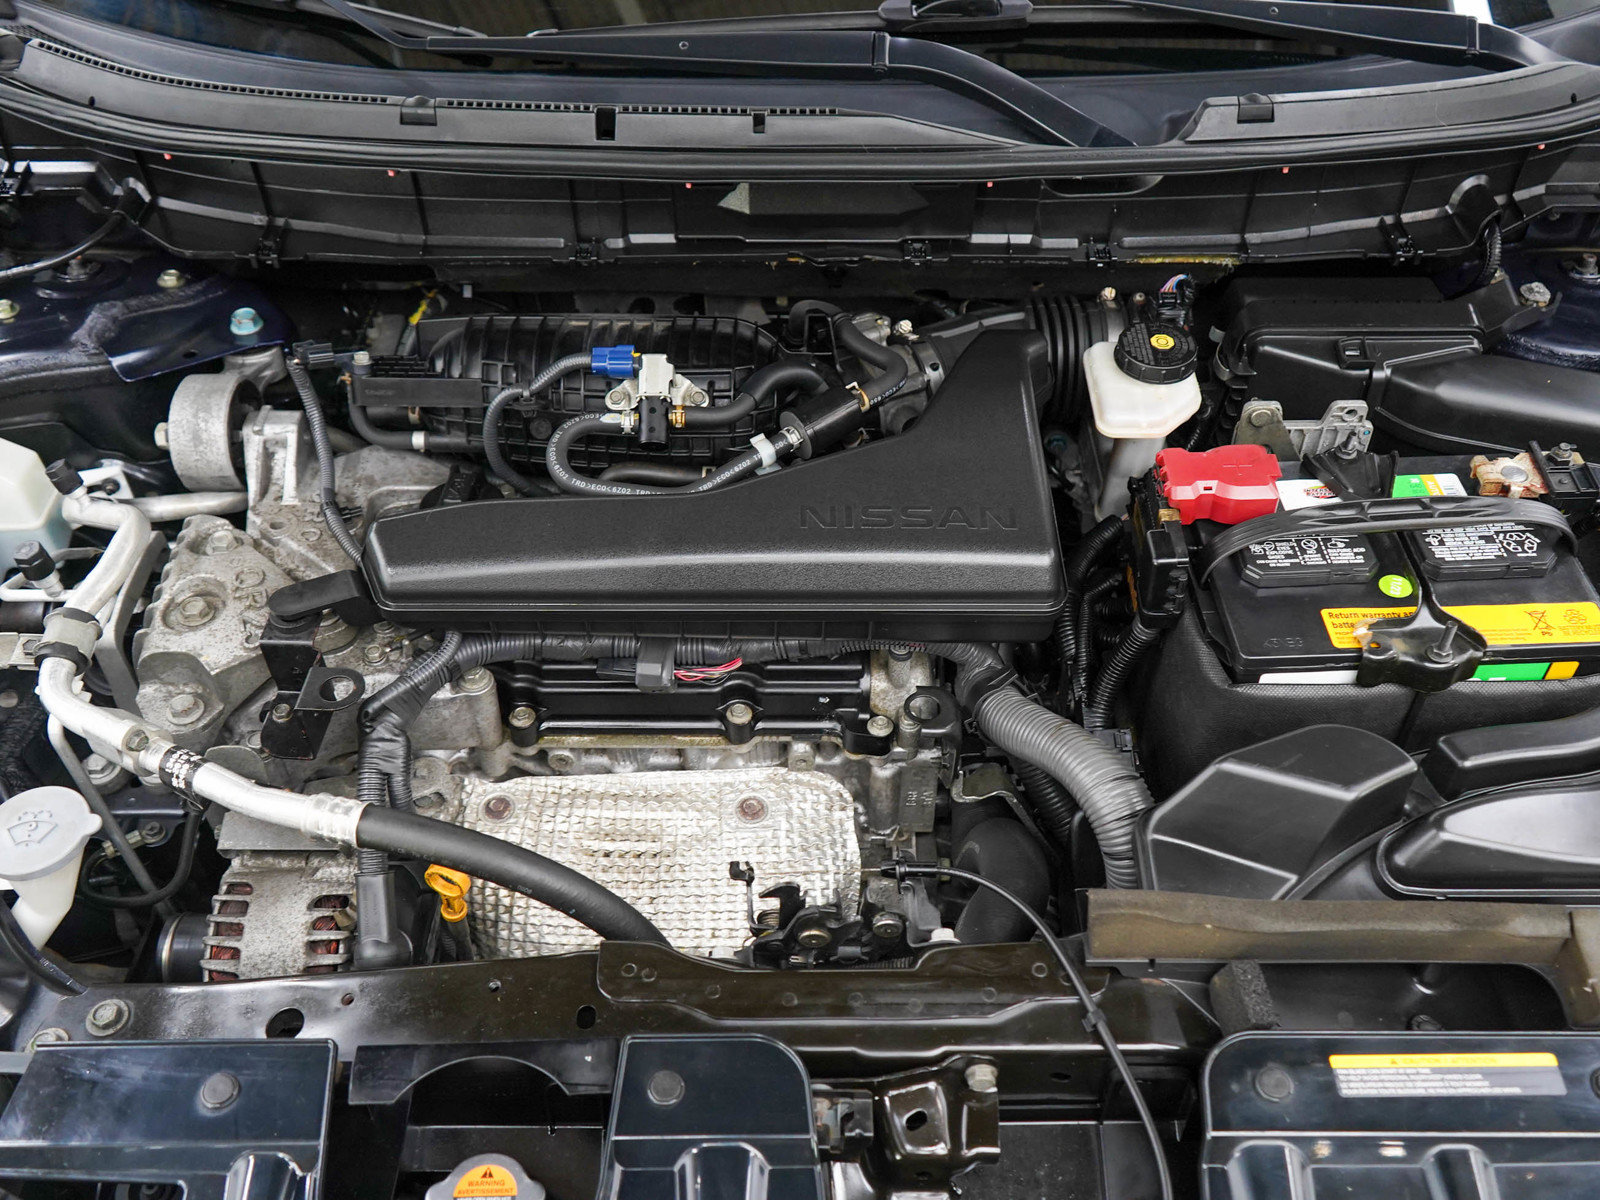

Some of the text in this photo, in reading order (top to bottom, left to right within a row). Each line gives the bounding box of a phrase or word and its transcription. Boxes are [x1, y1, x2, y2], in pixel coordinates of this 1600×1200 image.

[571, 478, 631, 495] TRD>ECO<6Z02
[800, 505, 1019, 530] NISSAN
[1328, 611, 1360, 619] Return
[1362, 611, 1401, 619] warranty
[1331, 621, 1355, 629] batte
